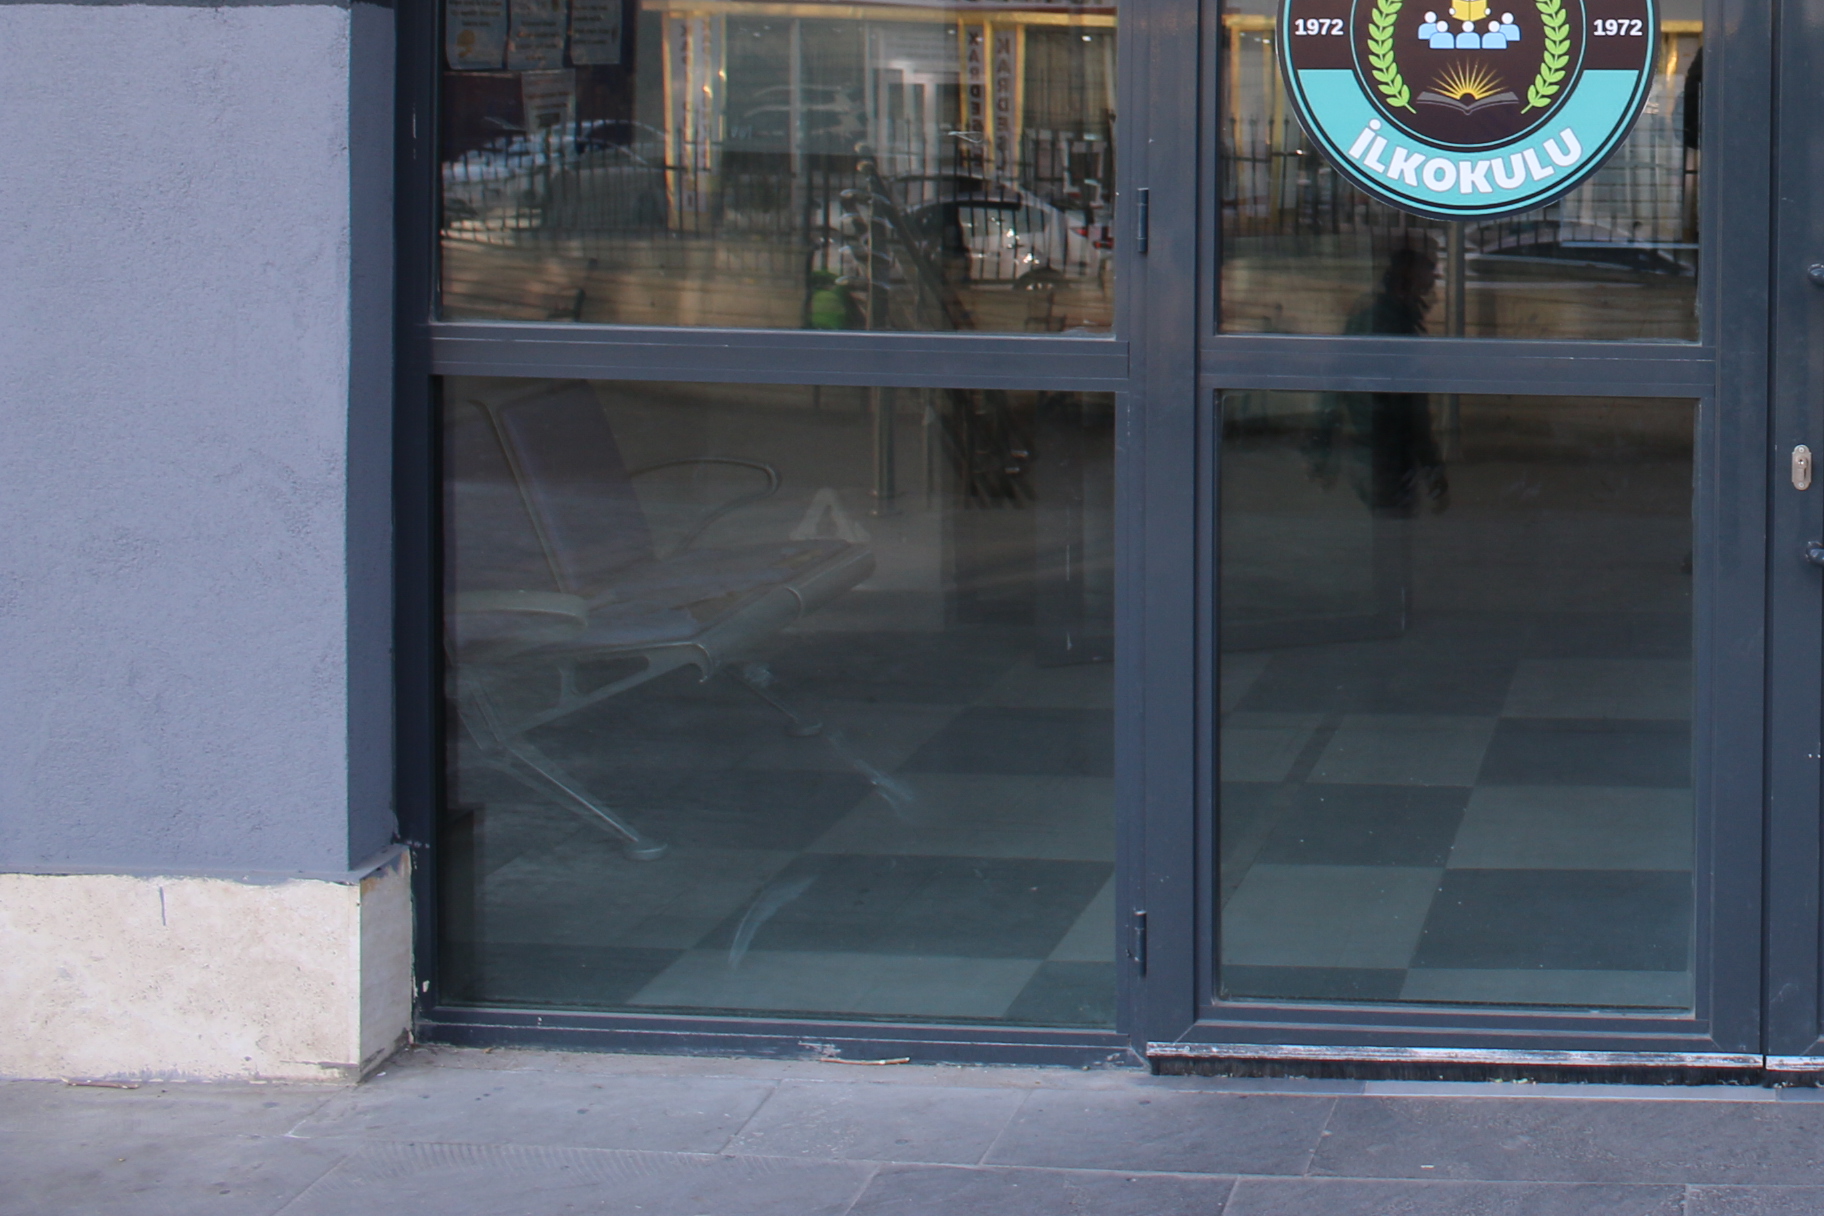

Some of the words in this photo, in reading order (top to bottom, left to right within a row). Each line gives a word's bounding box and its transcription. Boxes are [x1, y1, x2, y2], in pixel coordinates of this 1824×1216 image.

[1295, 18, 1344, 36] 1972
[1593, 19, 1643, 37] 1972
[1348, 119, 1584, 195] İLKOKULU
